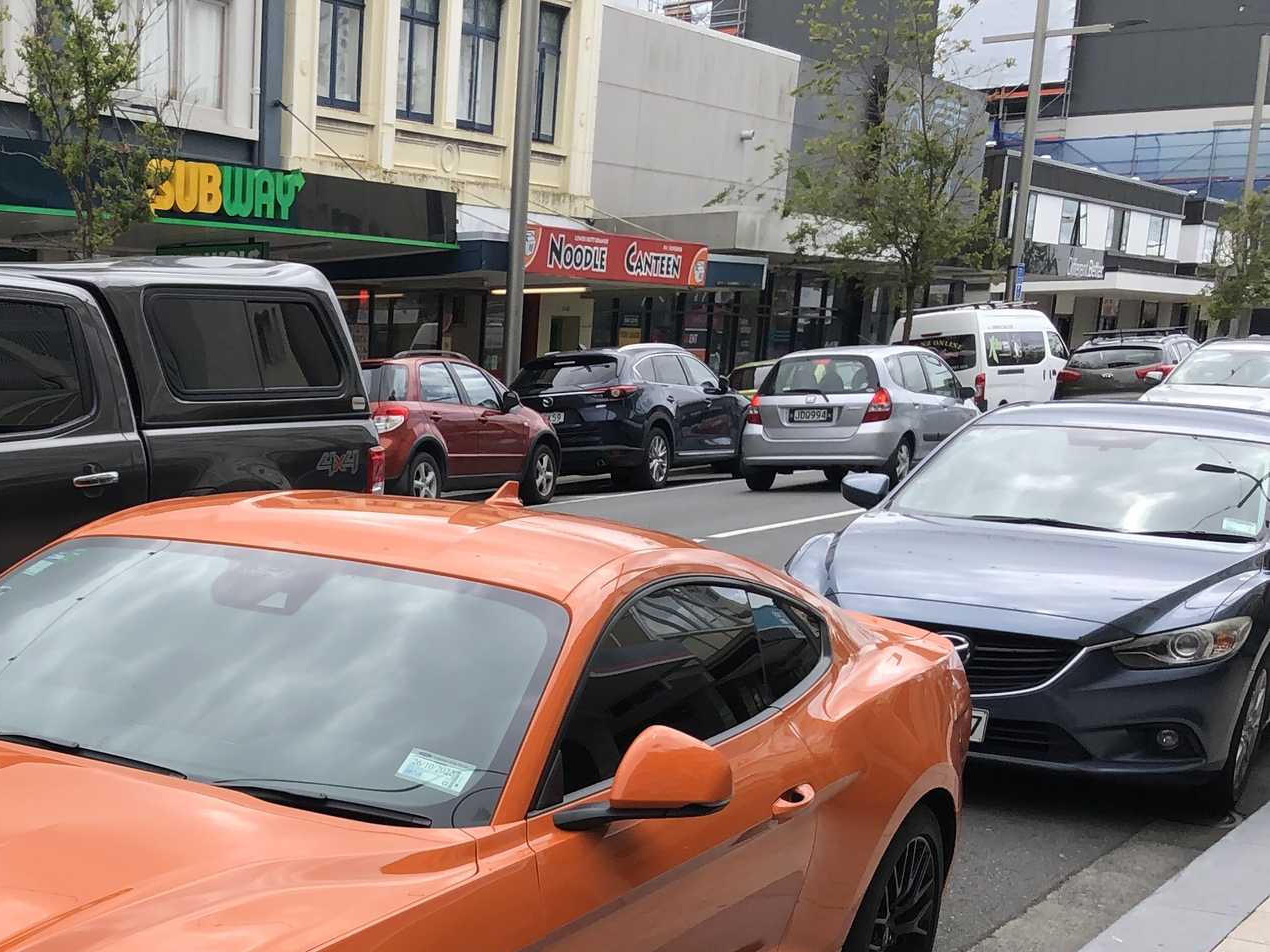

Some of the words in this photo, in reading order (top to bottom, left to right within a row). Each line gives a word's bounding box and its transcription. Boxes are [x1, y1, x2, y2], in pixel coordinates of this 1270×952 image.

[146, 158, 306, 221] SUBWAY
[547, 232, 608, 273] NOODLE
[624, 241, 682, 279] CANTEEN
[933, 339, 964, 351] ONLINE
